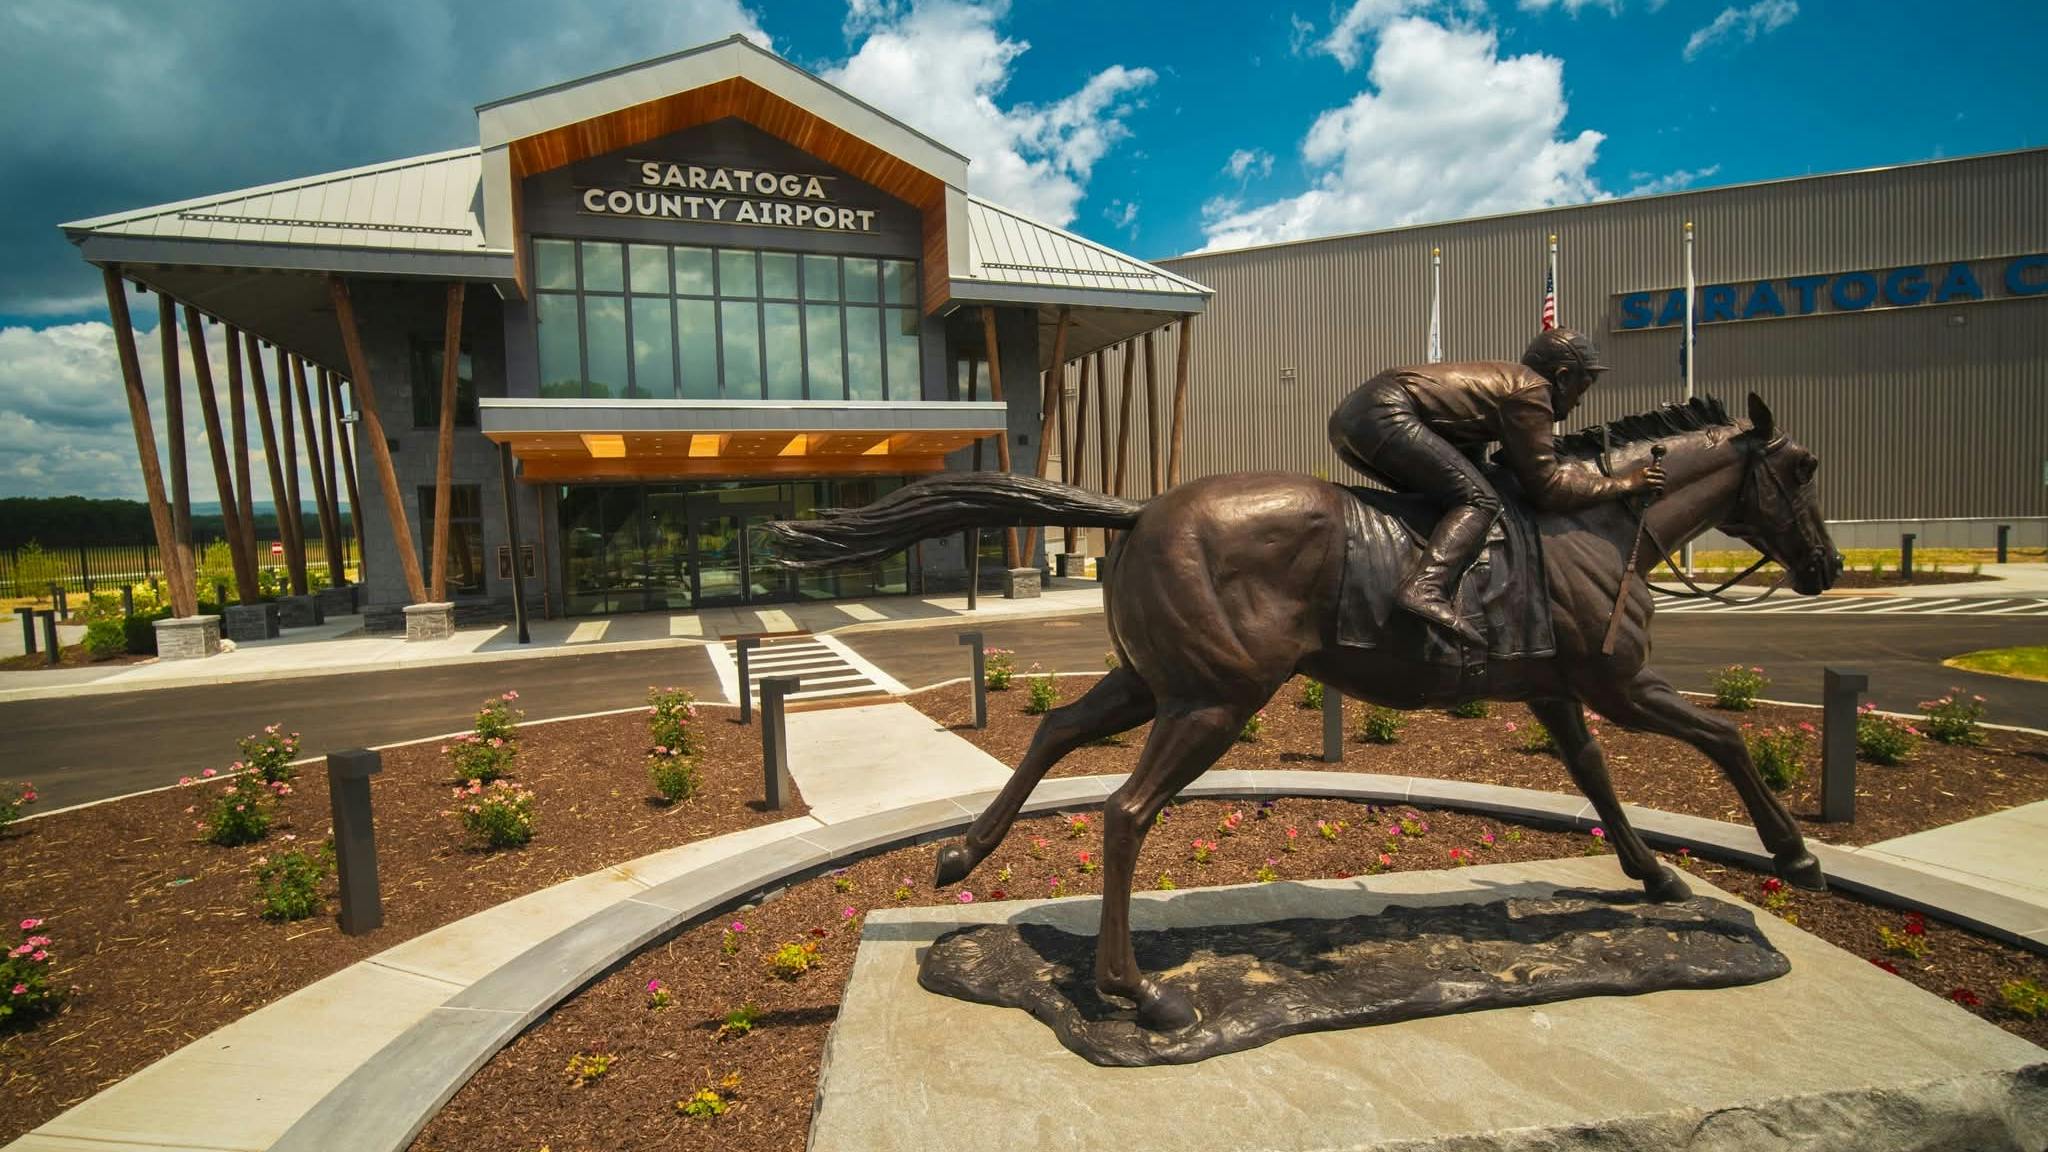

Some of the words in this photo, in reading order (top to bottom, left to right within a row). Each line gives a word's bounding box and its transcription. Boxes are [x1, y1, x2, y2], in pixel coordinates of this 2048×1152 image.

[641, 162, 826, 199] SARATOGA
[583, 188, 728, 220] COUNTY
[735, 200, 875, 231] AIRPORT
[1620, 263, 1983, 330] SARATOGA
